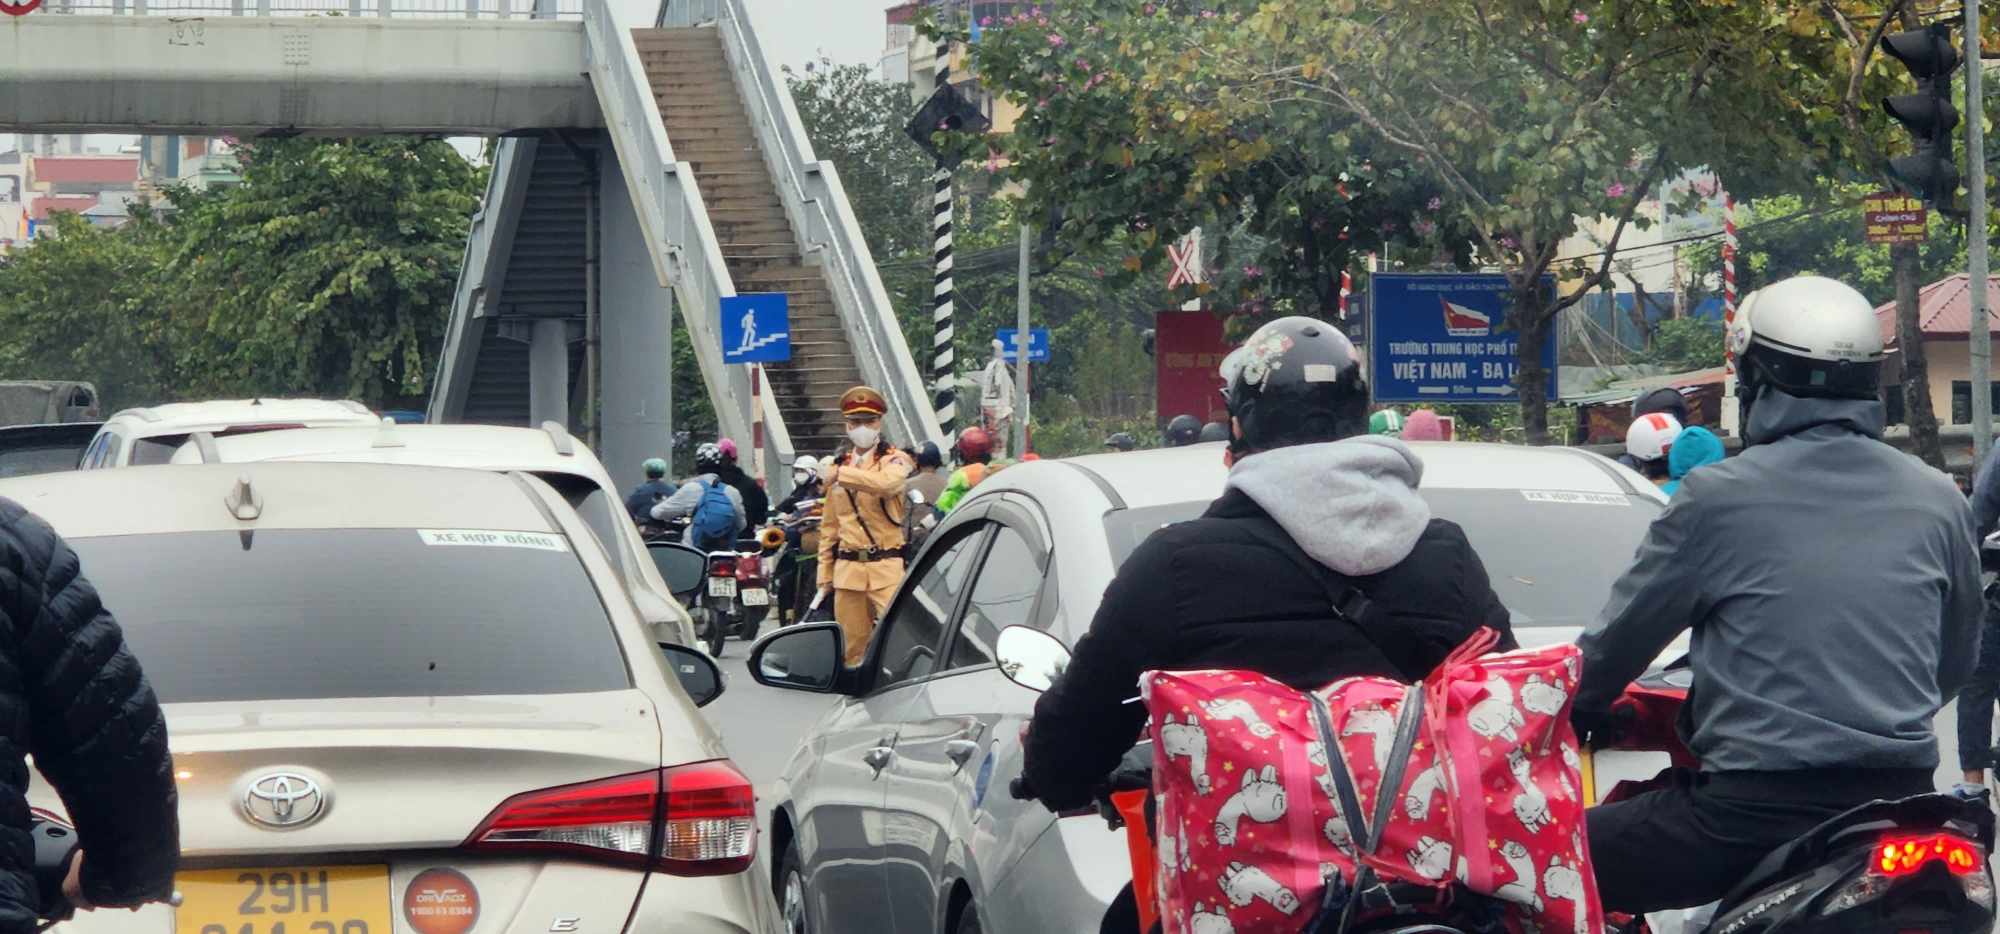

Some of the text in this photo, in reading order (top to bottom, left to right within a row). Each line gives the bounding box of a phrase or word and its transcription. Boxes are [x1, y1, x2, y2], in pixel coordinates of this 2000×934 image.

[1389, 340, 1429, 356] TRƯỜNG
[1431, 342, 1462, 356] TRUNG
[1464, 342, 1485, 358] HỌC
[1392, 360, 1426, 383] VIỆT
[1430, 362, 1467, 380] NAM
[1482, 362, 1505, 380] BA
[432, 533, 457, 543] XE
[237, 870, 329, 916] 29H
[549, 916, 581, 933] E
